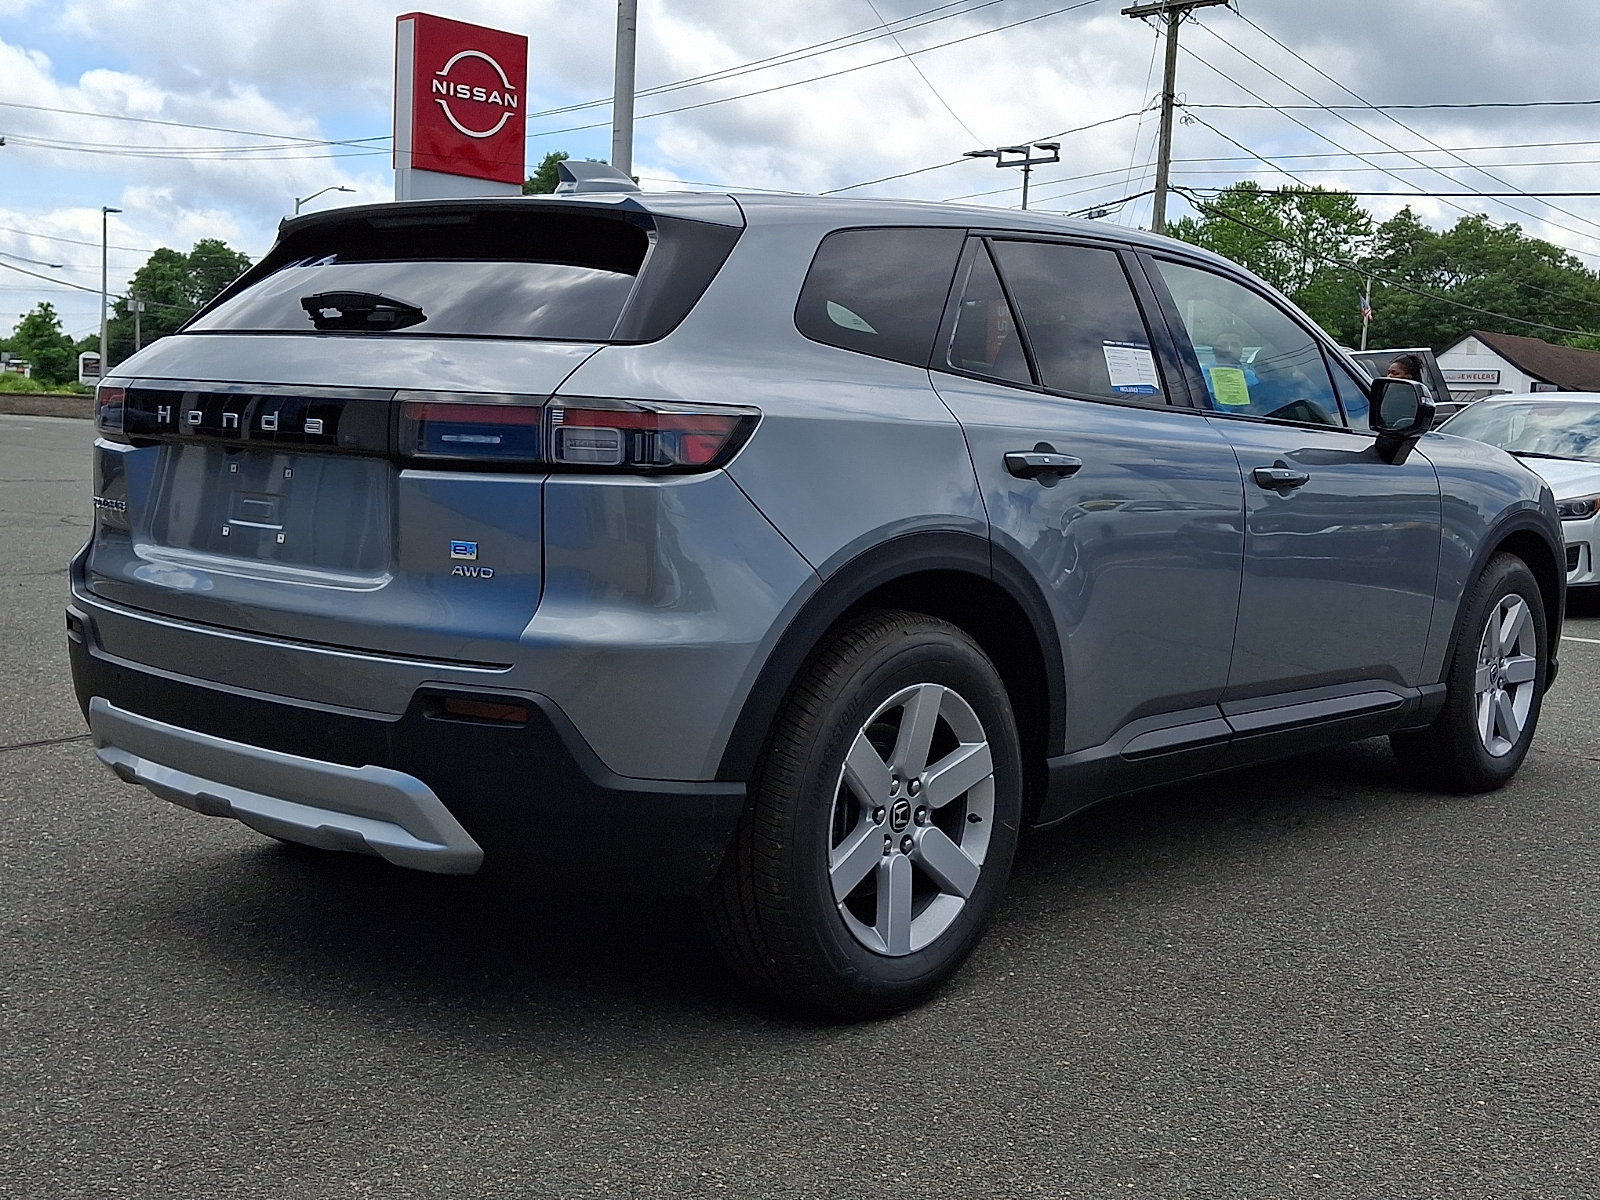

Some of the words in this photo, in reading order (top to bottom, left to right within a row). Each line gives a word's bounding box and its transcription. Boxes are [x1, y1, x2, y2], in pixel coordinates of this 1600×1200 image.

[432, 79, 518, 108] NISSAN
[157, 405, 323, 434] Honda
[451, 565, 494, 579] AWD
